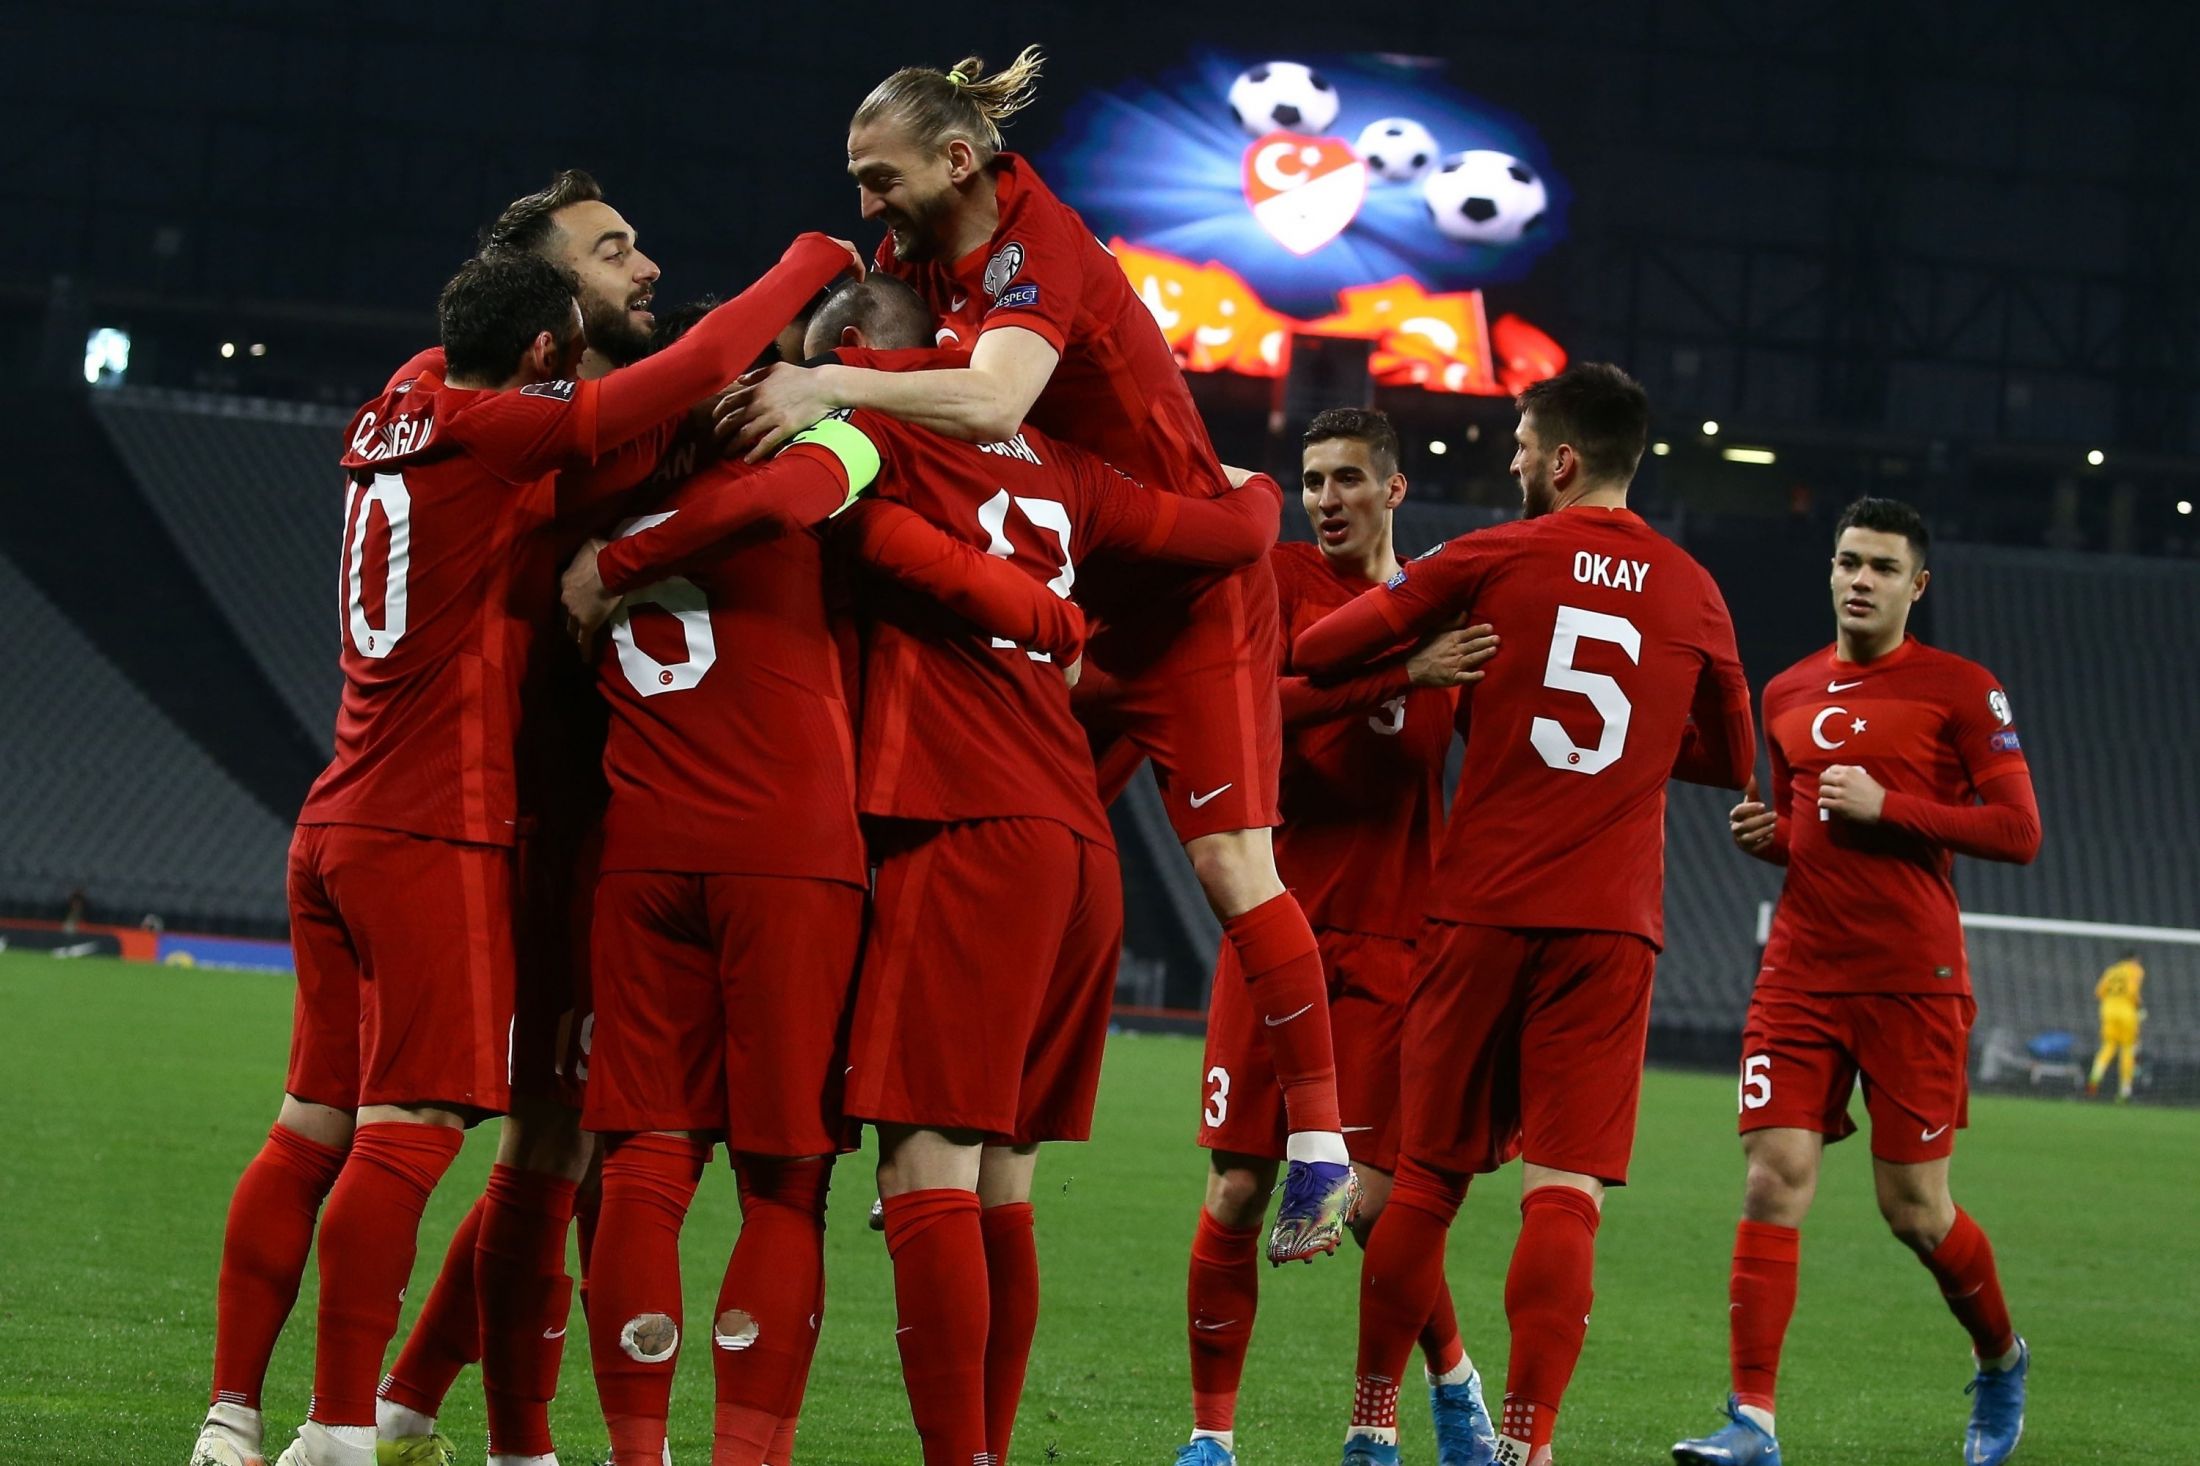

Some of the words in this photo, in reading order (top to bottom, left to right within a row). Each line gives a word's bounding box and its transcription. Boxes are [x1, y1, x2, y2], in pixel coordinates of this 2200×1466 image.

[612, 510, 717, 697] 6
[1573, 551, 1650, 592] OKAY
[1530, 605, 1642, 775] 5
[1205, 1066, 1230, 1128] 3
